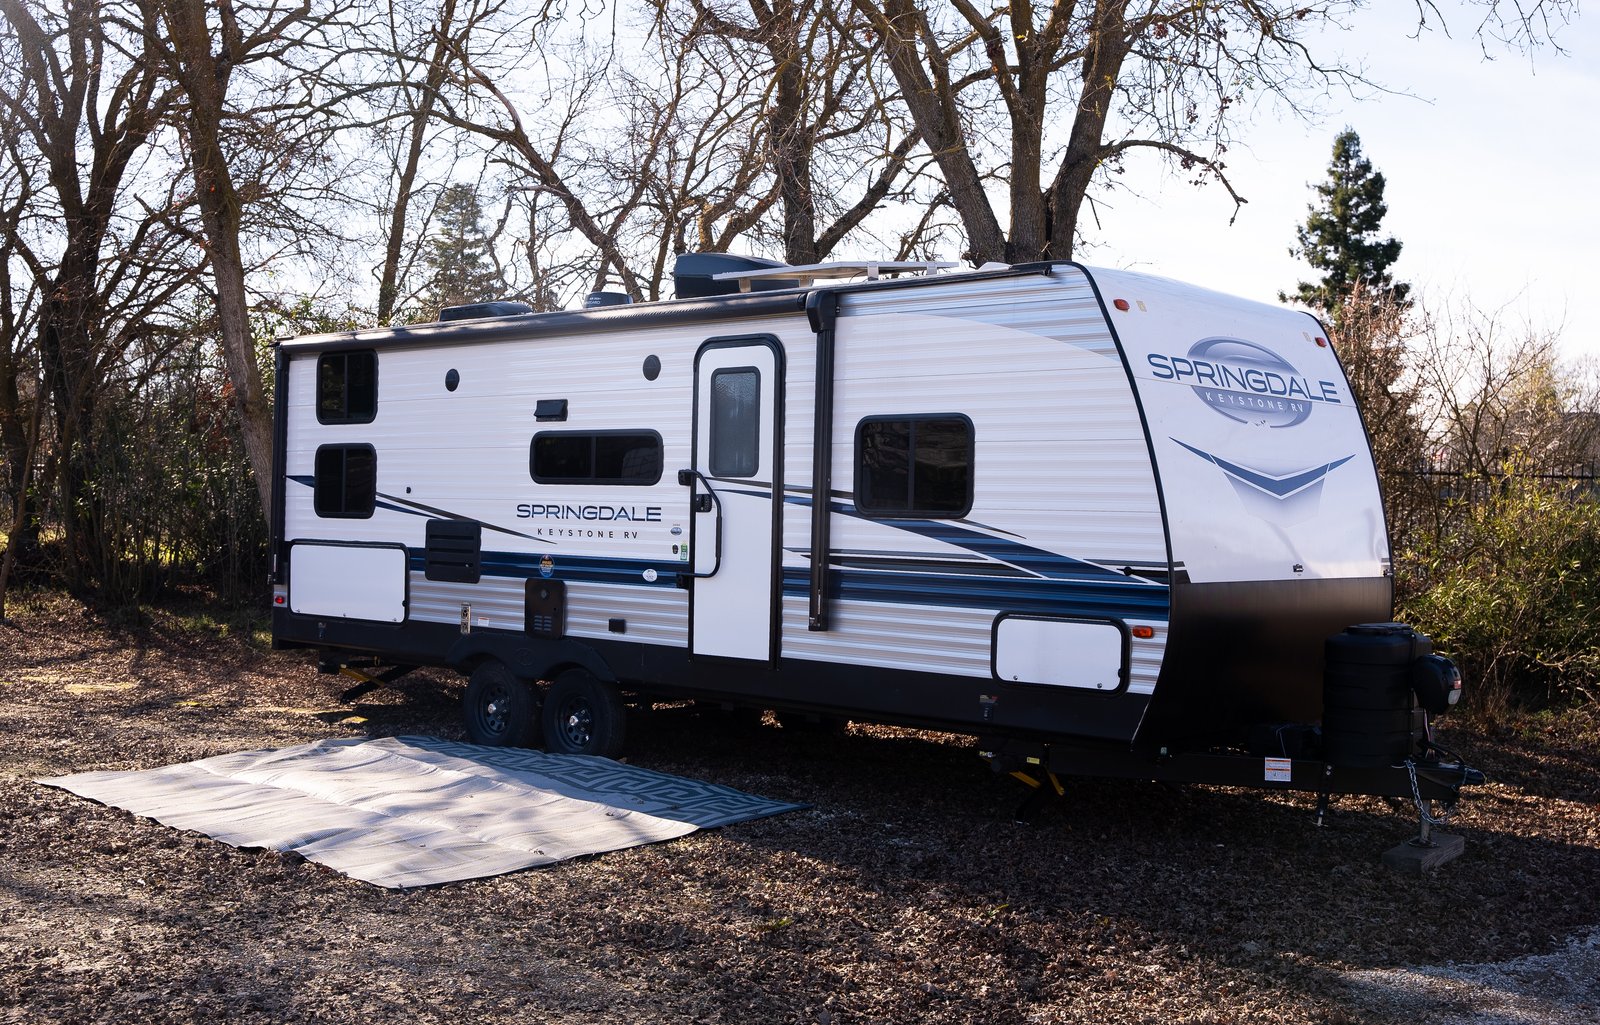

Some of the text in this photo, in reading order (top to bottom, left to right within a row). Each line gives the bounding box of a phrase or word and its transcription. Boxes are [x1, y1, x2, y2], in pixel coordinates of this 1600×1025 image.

[1147, 353, 1341, 403] SPRINGDALE
[1206, 391, 1304, 413] KEYSTONE RV
[516, 504, 662, 522] SPRINGDALE
[537, 528, 638, 539] KEYSTONE RV
